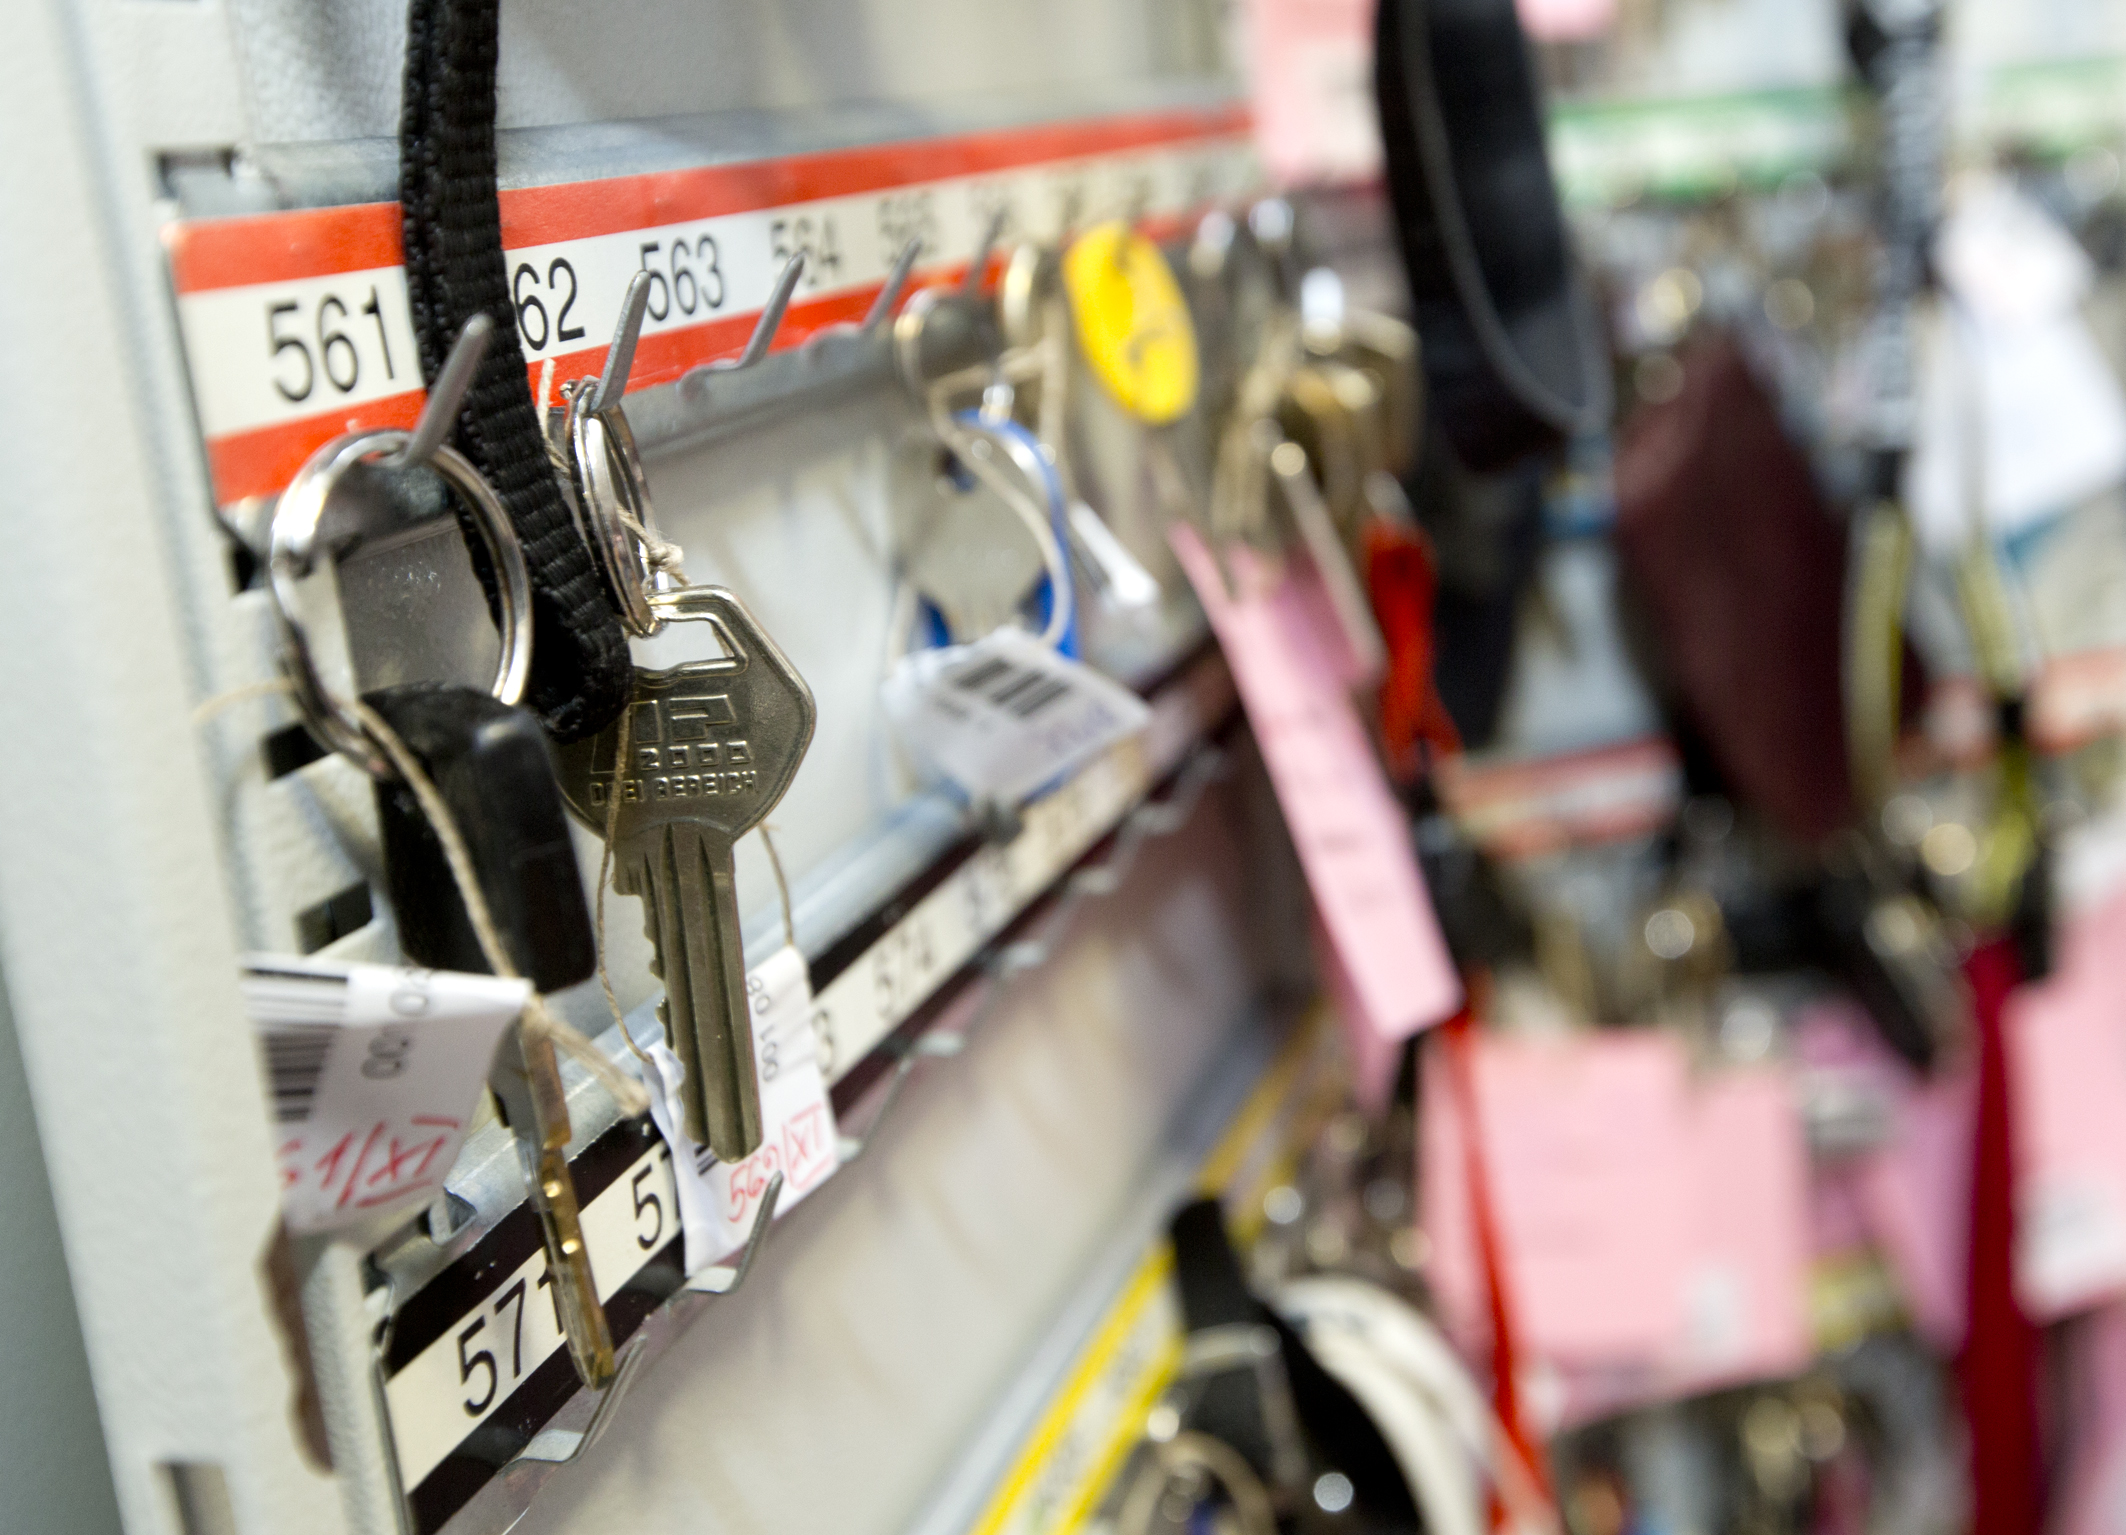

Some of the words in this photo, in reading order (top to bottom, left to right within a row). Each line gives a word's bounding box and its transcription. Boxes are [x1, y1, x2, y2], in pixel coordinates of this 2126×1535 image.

[639, 234, 725, 322] 563
[770, 214, 842, 288] 564
[266, 284, 396, 402] 561
[512, 257, 586, 351] 62
[457, 1268, 565, 1418] 571
